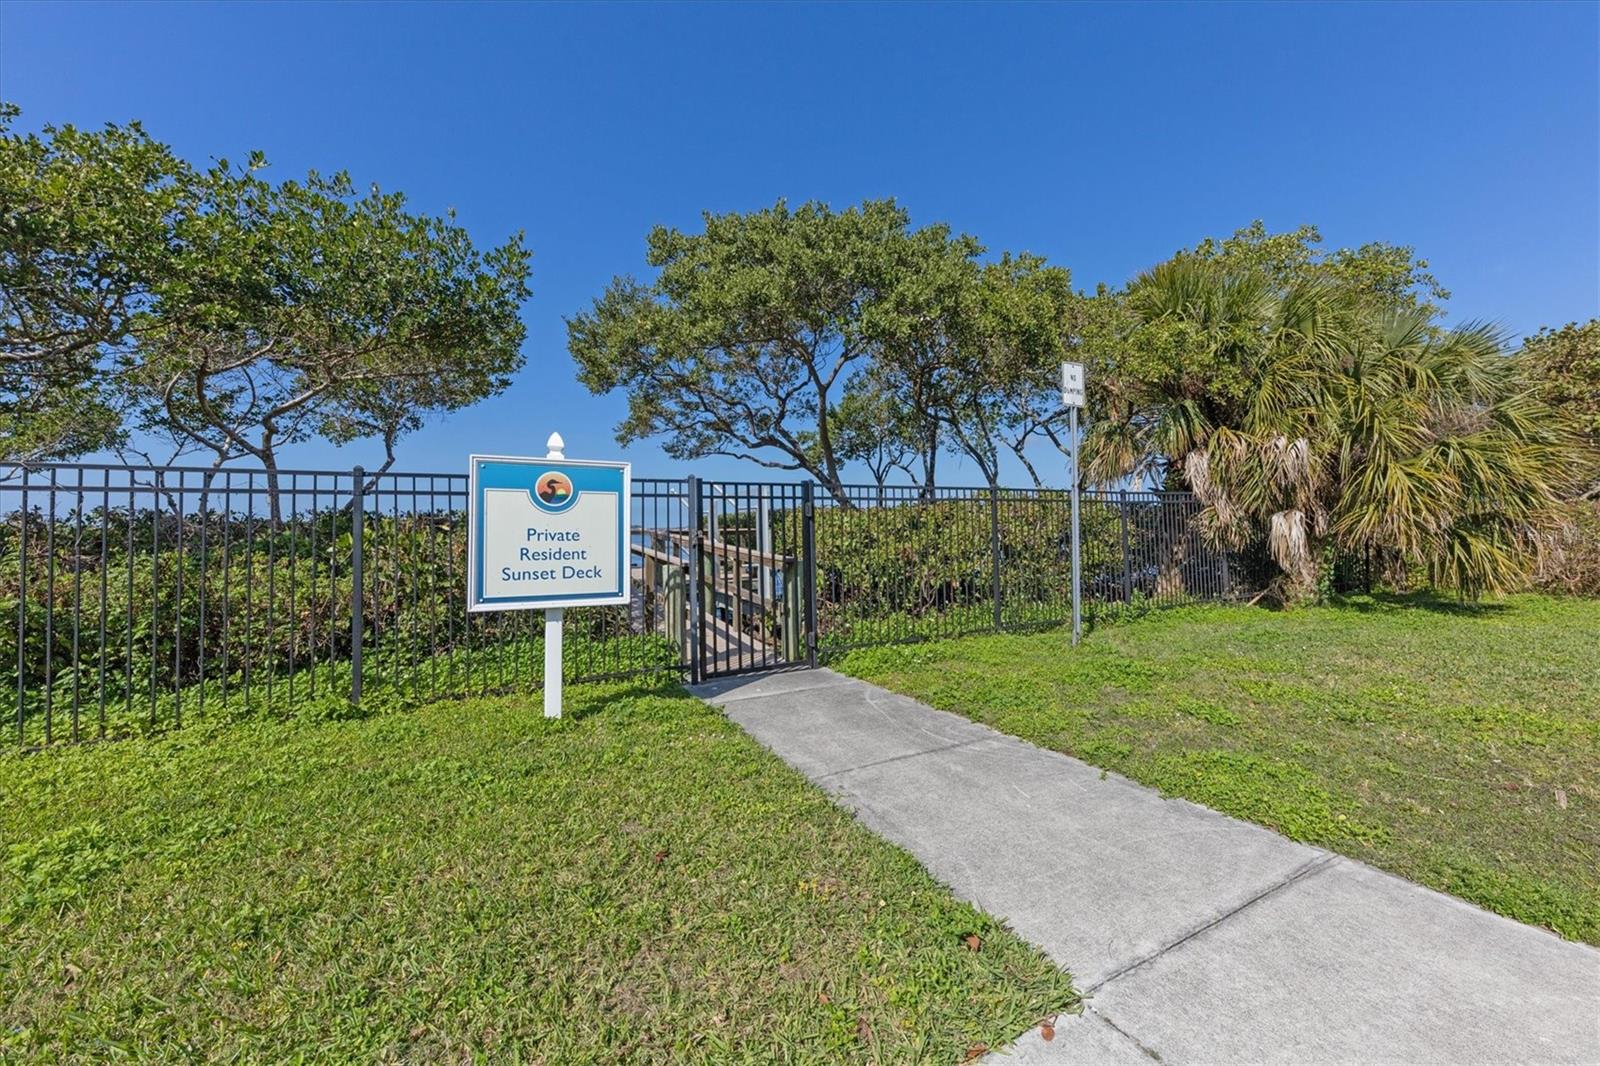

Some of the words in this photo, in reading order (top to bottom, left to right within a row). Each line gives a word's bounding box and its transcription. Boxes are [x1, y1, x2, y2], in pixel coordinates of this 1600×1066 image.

[527, 528, 580, 541] Private
[520, 547, 587, 561] Resident
[502, 567, 556, 581] Sunset
[562, 565, 602, 579] Deck
